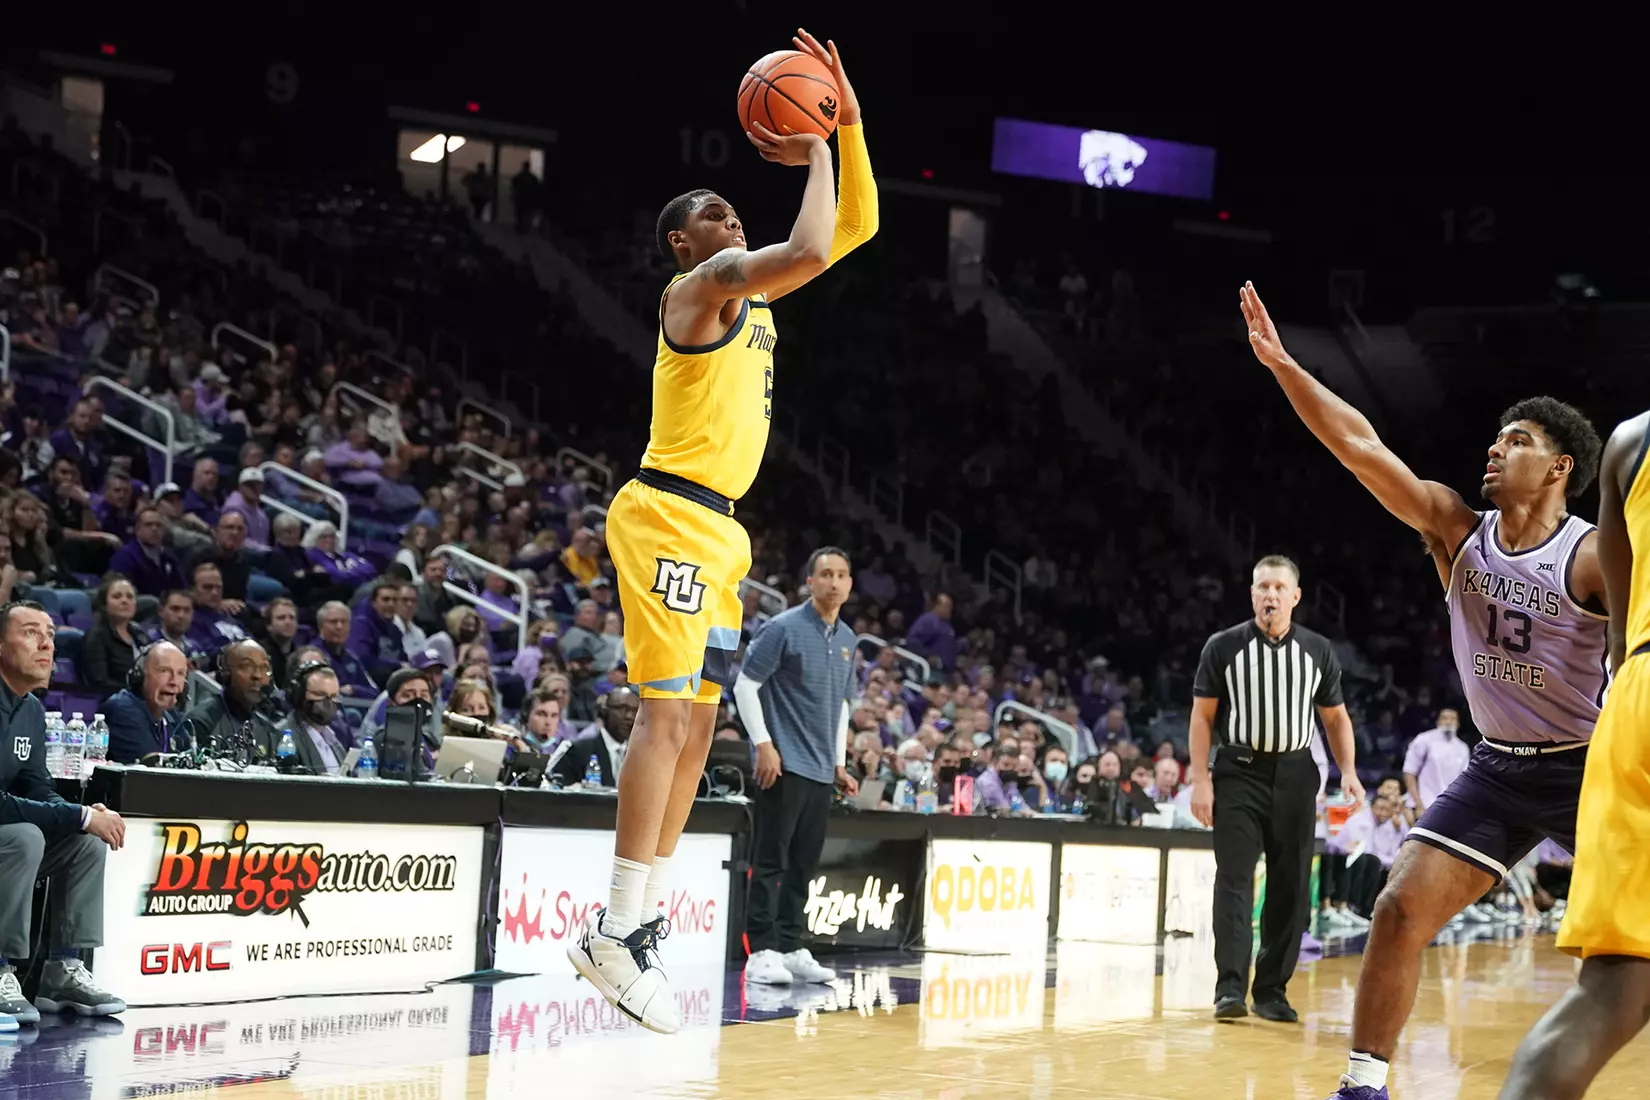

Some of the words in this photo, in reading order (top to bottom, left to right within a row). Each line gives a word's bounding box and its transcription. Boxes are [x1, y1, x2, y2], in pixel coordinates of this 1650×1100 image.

[265, 61, 299, 104] 9
[677, 126, 730, 168] 10
[1441, 205, 1497, 243] 12
[650, 557, 707, 615] MU
[1463, 570, 1561, 617] KANSAS
[1486, 604, 1533, 655] 13
[1473, 653, 1545, 688] STATE
[14, 736, 31, 761] MU
[148, 894, 186, 913] AUTO
[187, 893, 234, 912] GROUP
[931, 863, 1035, 931] QDOBA
[140, 941, 232, 975] GMC
[246, 944, 268, 962] WE
[274, 942, 301, 960] ARE
[306, 937, 408, 959] PROFESSIONAL
[412, 935, 453, 953] GRADE
